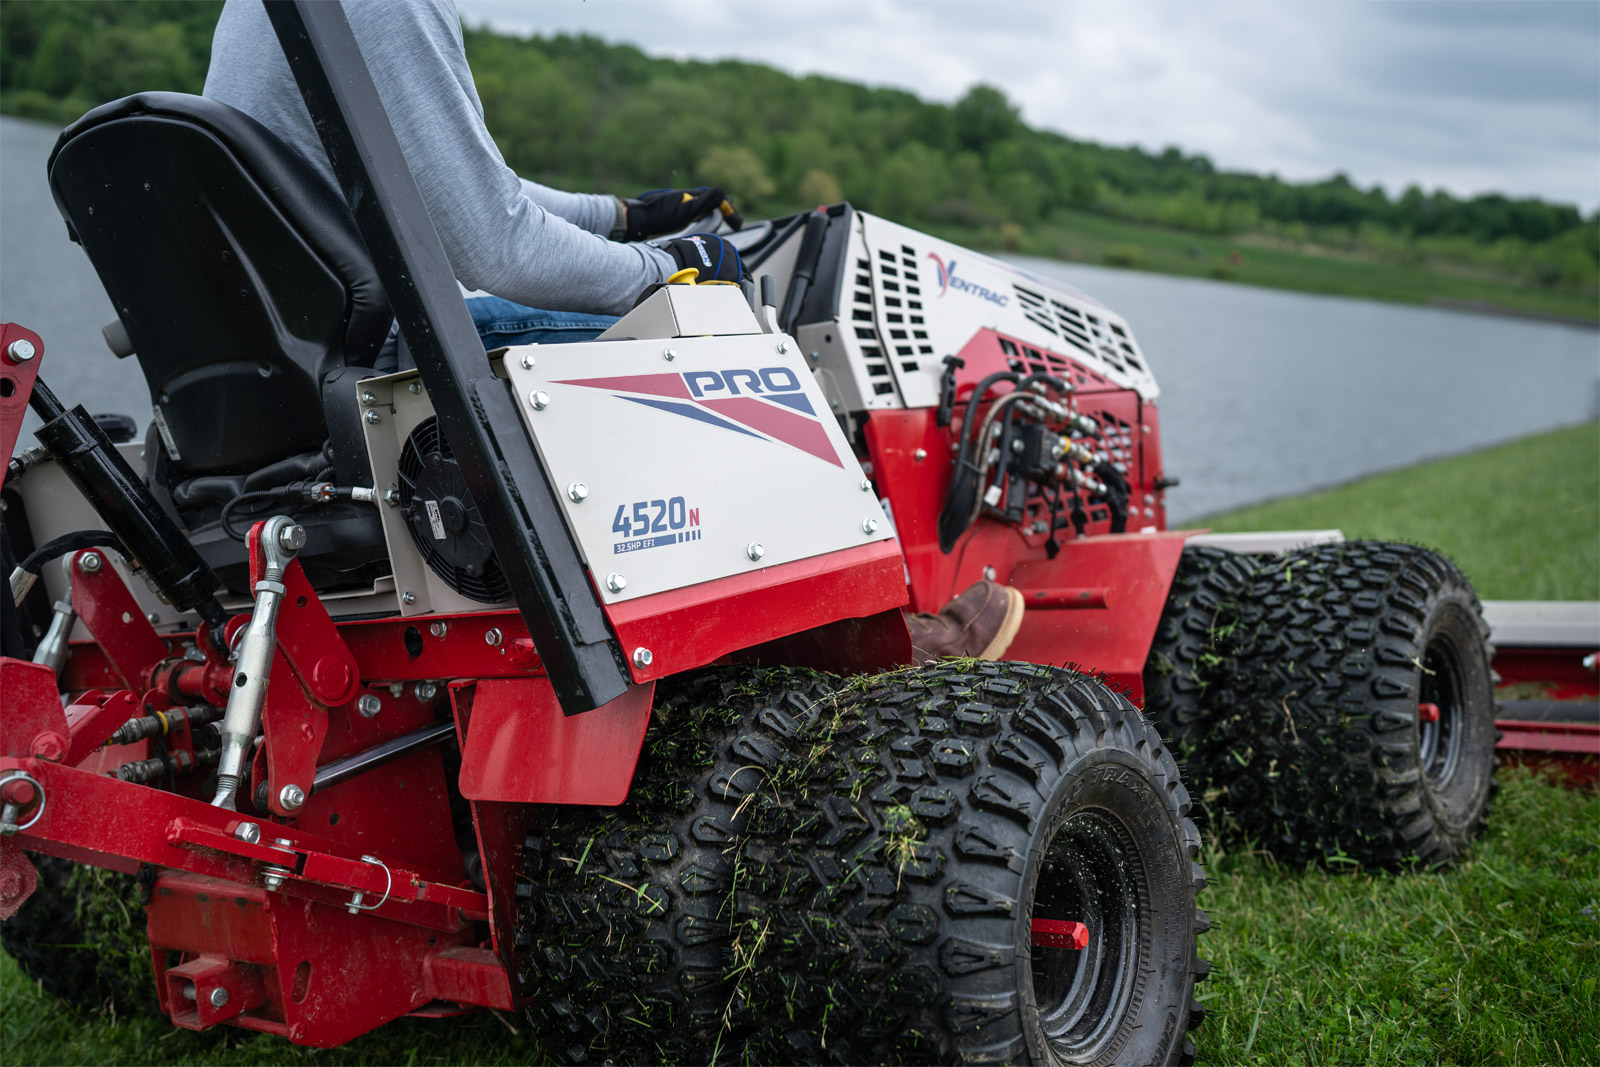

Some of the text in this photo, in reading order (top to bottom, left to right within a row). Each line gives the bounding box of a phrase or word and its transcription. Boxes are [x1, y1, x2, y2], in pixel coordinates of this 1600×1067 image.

[926, 251, 1010, 308] VENTRAC
[682, 366, 802, 398] PRO
[616, 539, 655, 553] 32.5HP EFI
